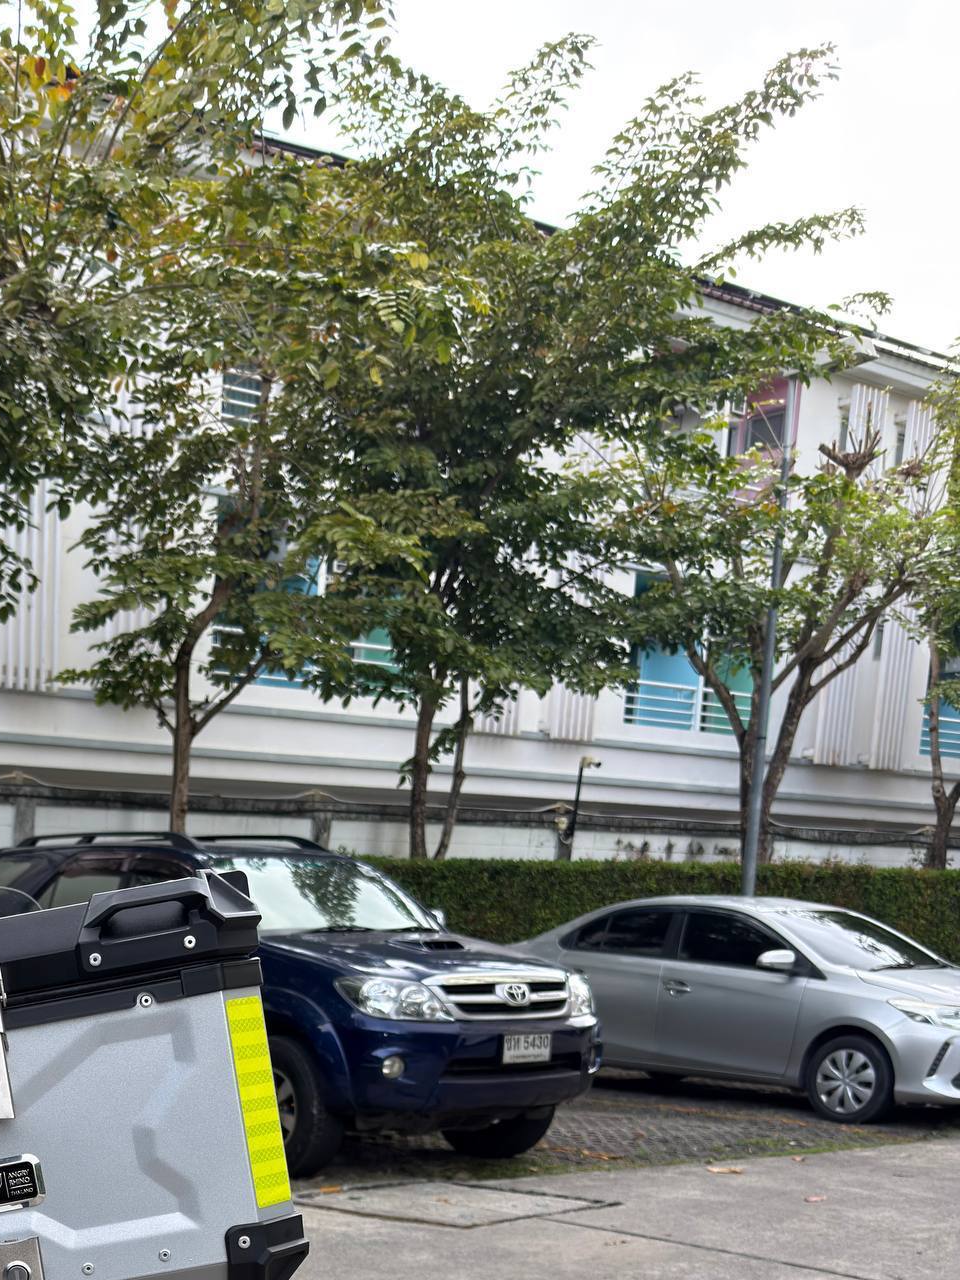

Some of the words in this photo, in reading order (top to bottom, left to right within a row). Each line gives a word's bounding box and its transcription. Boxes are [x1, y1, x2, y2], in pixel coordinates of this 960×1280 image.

[523, 1035, 549, 1051] 5430
[8, 1169, 30, 1179] ANGRY
[9, 1176, 31, 1187] RHINO
